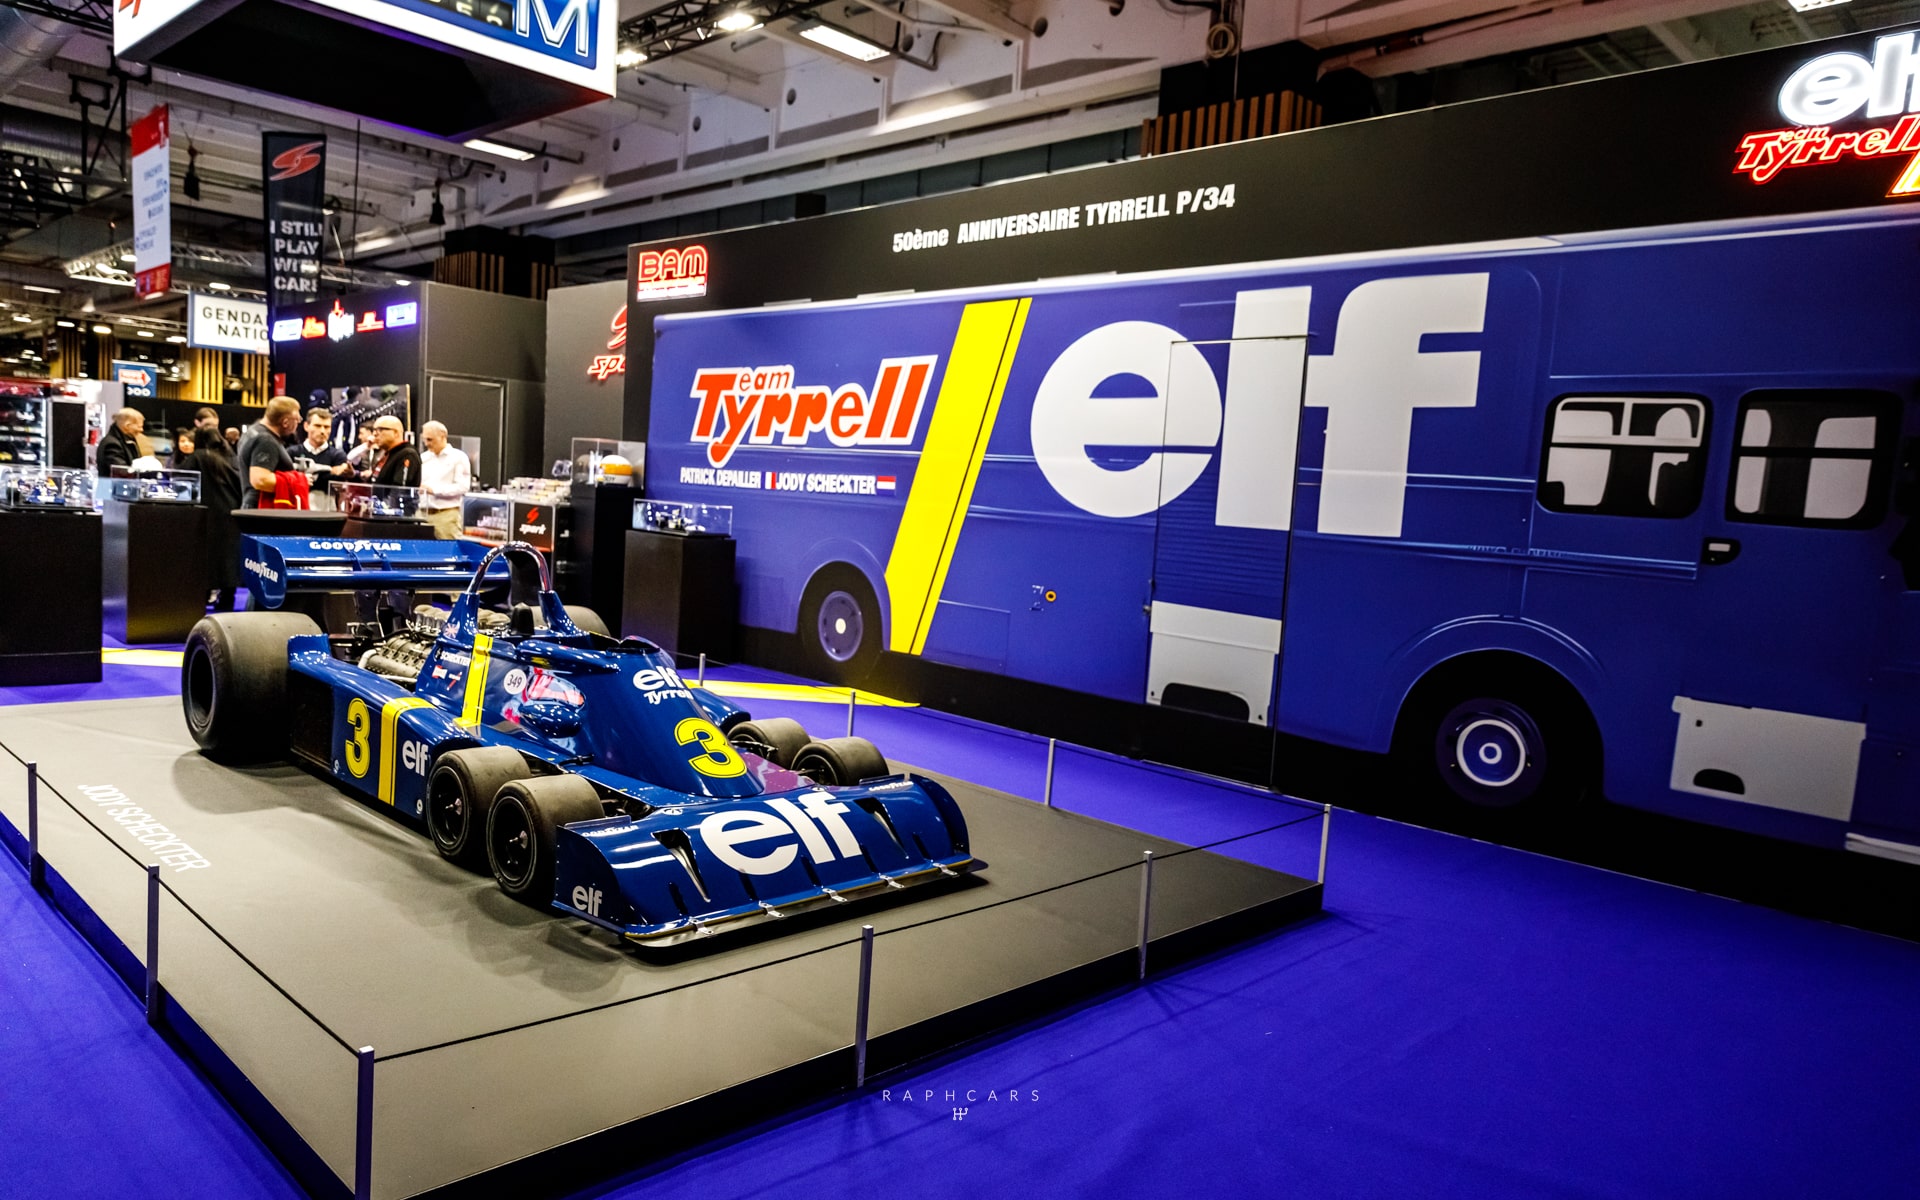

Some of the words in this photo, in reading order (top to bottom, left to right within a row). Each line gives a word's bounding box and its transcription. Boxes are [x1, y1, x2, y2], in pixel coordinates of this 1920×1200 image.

[893, 228, 949, 252] 50ème
[957, 205, 1080, 245] ANNIVERSAIRE
[1085, 194, 1170, 226] TYRRELL
[1175, 184, 1236, 215] P/34
[274, 238, 319, 255] PLAY
[638, 246, 708, 281] BAM
[202, 306, 263, 325] GENDA
[690, 355, 938, 467] Tyrrell
[1030, 272, 1489, 537] elf
[680, 467, 716, 485] PATRICK
[716, 469, 762, 489] DEPAILLER
[775, 473, 804, 492] JODY
[806, 475, 877, 494] SCHECKTER
[309, 540, 402, 552] GOODYEAR
[244, 557, 279, 583] GOODYEAR
[507, 673, 523, 687] 349
[345, 697, 371, 779] 3
[674, 717, 748, 779] 3
[402, 739, 429, 777] elf
[106, 807, 211, 872] SCHECKTER
[700, 791, 863, 875] elf
[572, 885, 603, 917] elf
